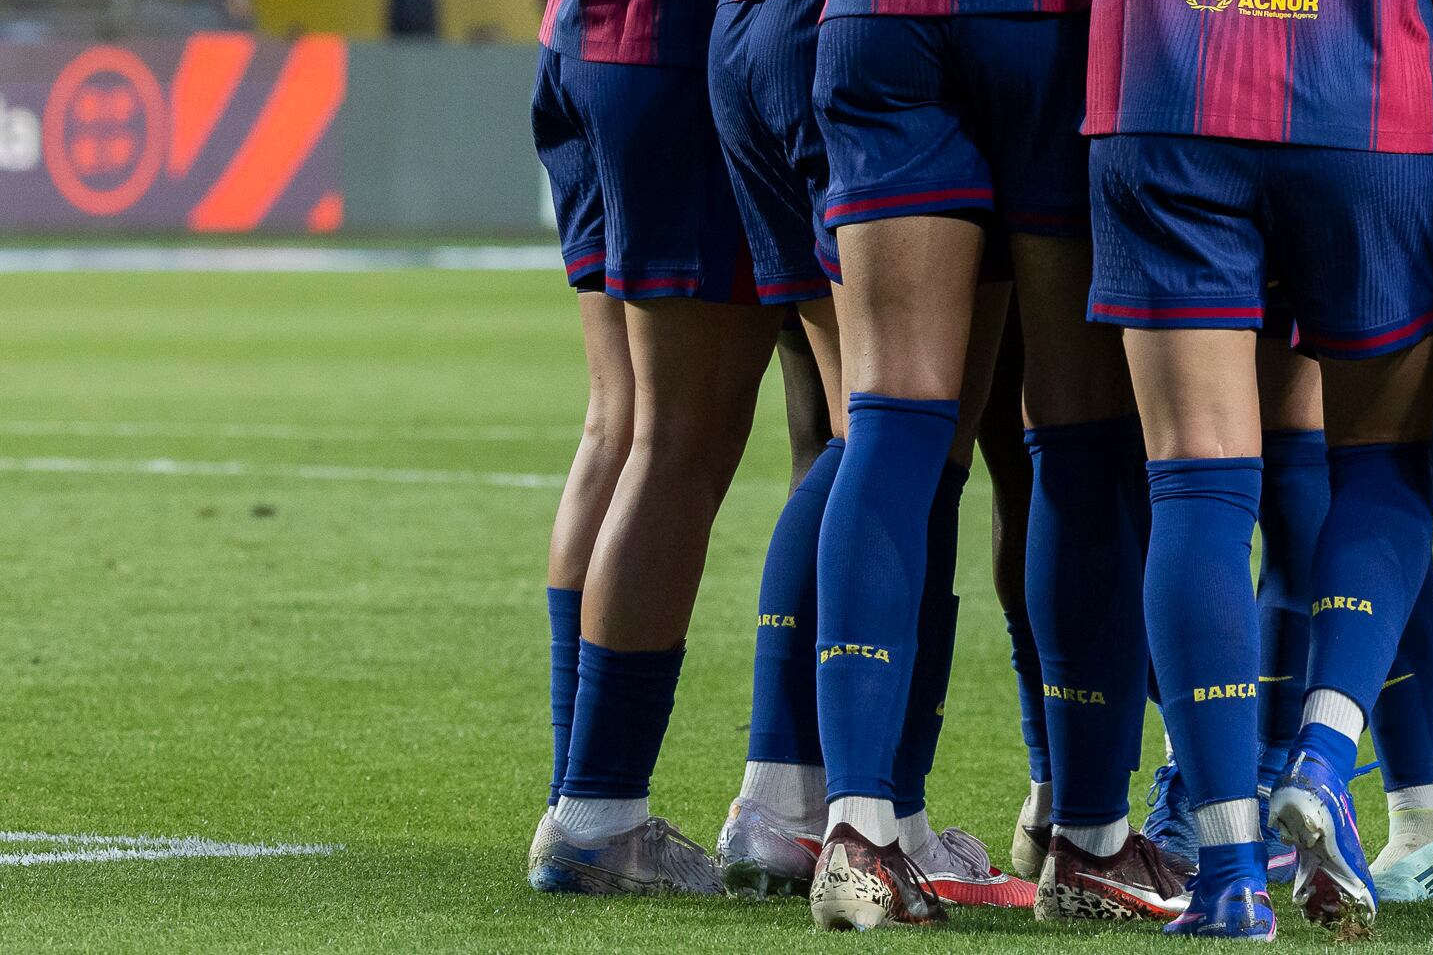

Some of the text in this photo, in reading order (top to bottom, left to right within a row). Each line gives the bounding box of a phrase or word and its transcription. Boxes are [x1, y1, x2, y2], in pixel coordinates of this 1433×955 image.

[1239, 8, 1318, 20] The UN Refugee Agency
[1193, 683, 1257, 702] BARÇA
